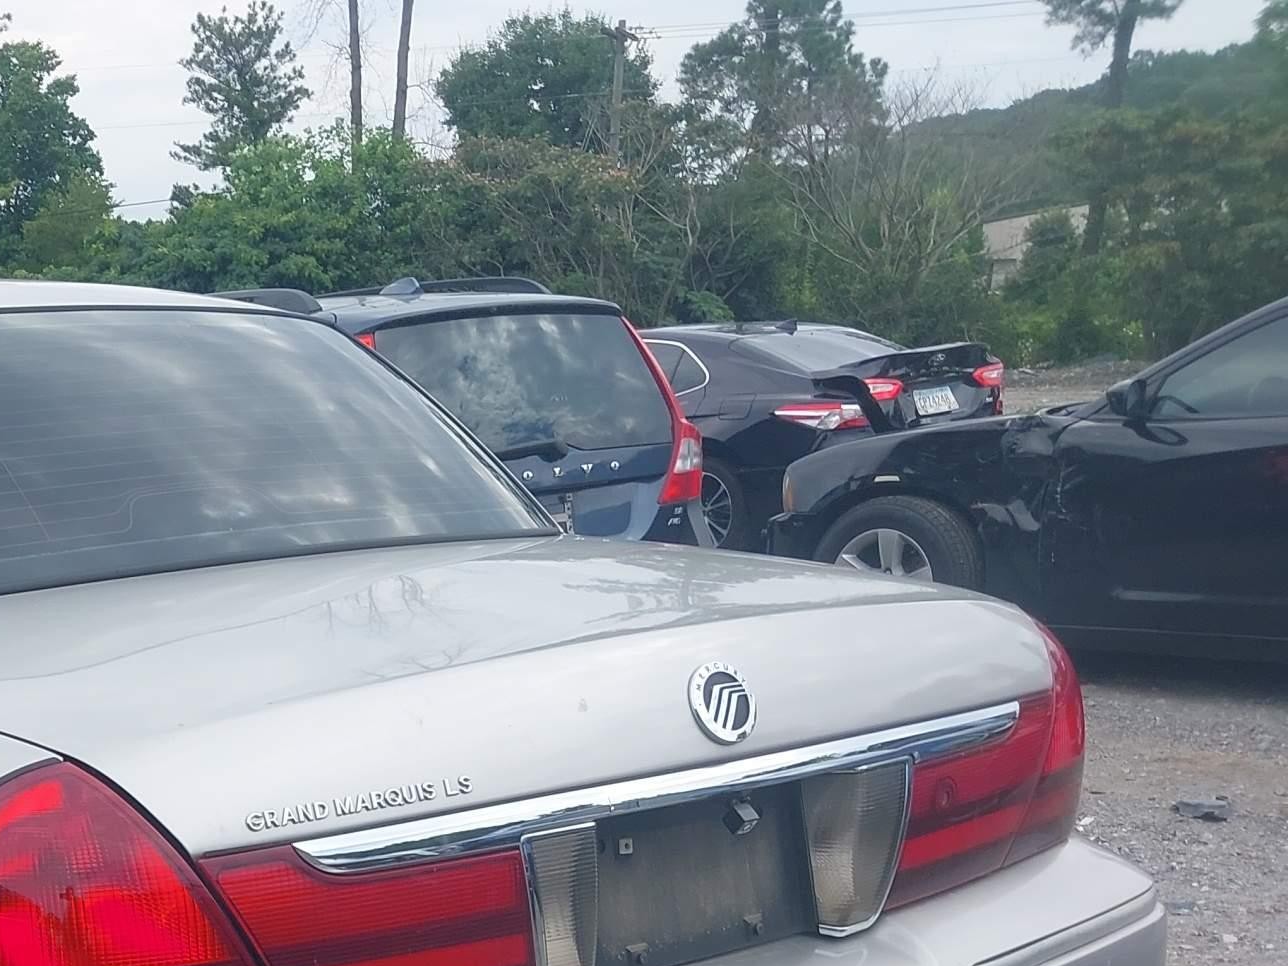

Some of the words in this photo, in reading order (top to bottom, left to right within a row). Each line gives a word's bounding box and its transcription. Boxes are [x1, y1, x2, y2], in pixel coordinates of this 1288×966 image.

[523, 461, 620, 481] OLVO
[246, 800, 329, 831] GRAND
[333, 781, 436, 816] MARQUIS
[442, 775, 473, 797] LS
